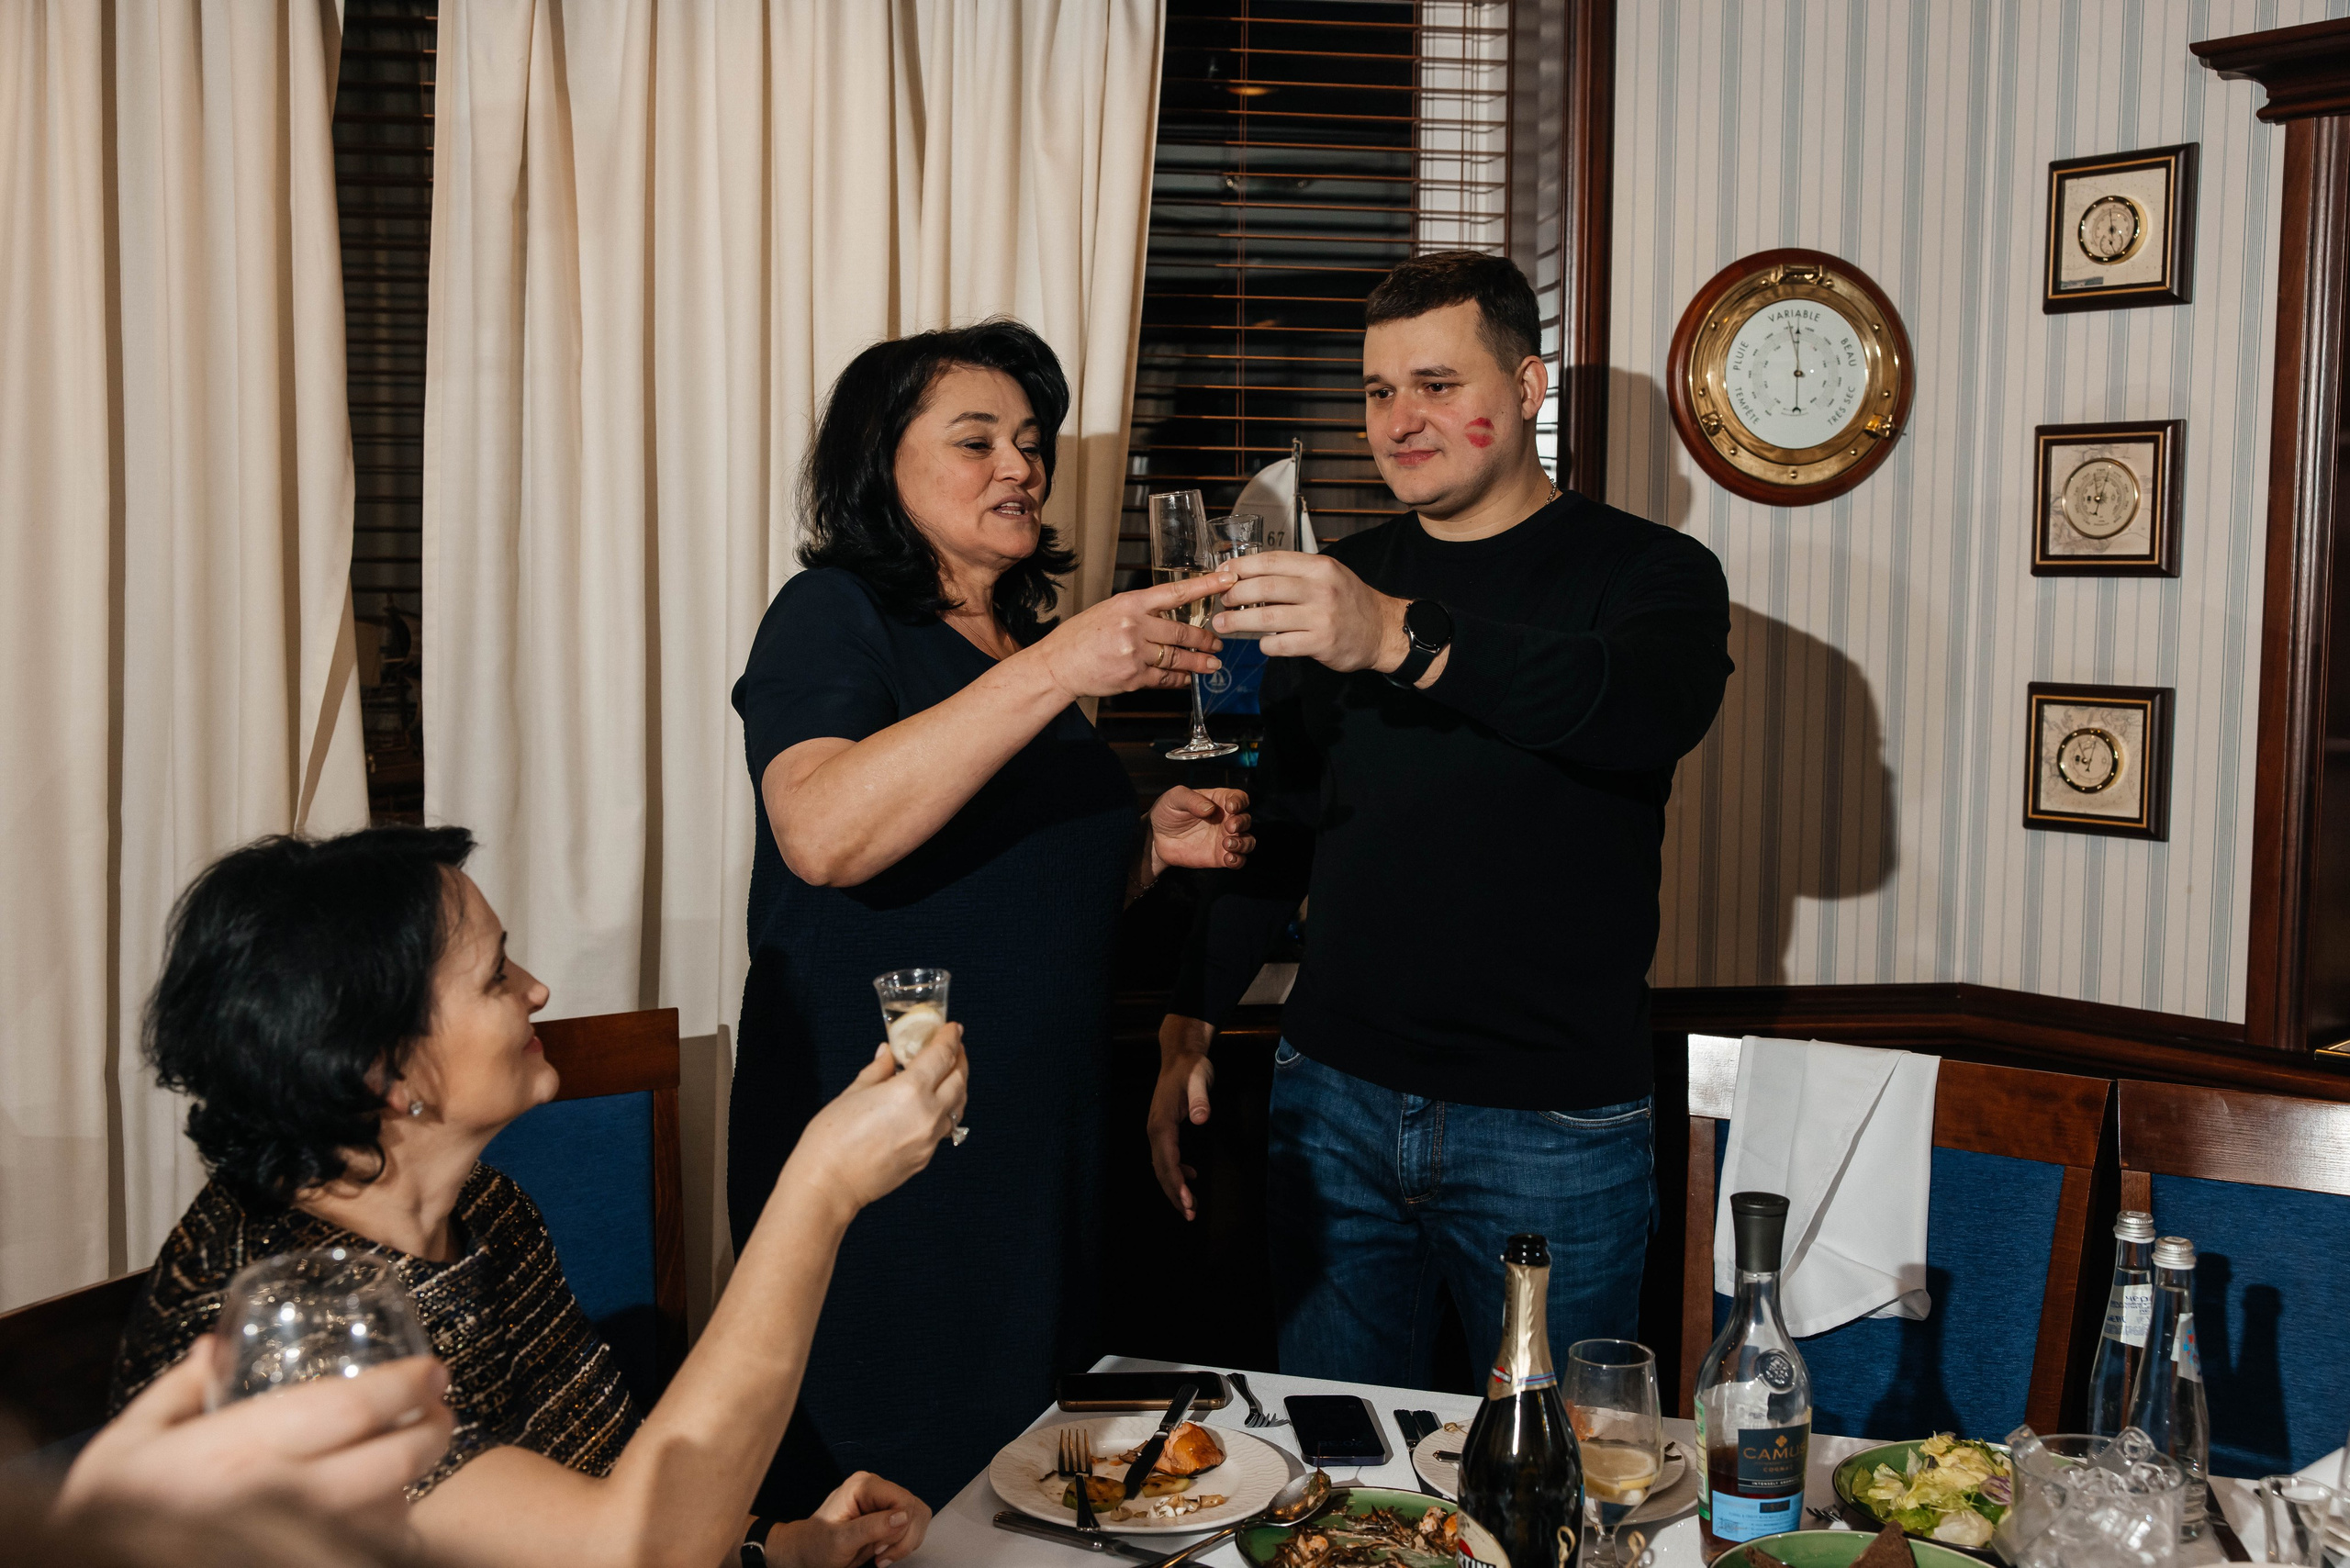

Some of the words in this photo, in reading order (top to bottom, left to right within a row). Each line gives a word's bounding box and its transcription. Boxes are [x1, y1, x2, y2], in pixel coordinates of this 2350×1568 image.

[1767, 308, 1820, 322] VARIABLE
[1732, 341, 1750, 371] PLUIE
[1841, 337, 1857, 367] BEAU
[1843, 386, 1856, 405] SEC
[1267, 530, 1285, 547] 67
[1742, 1441, 1807, 1462] CAMUS
